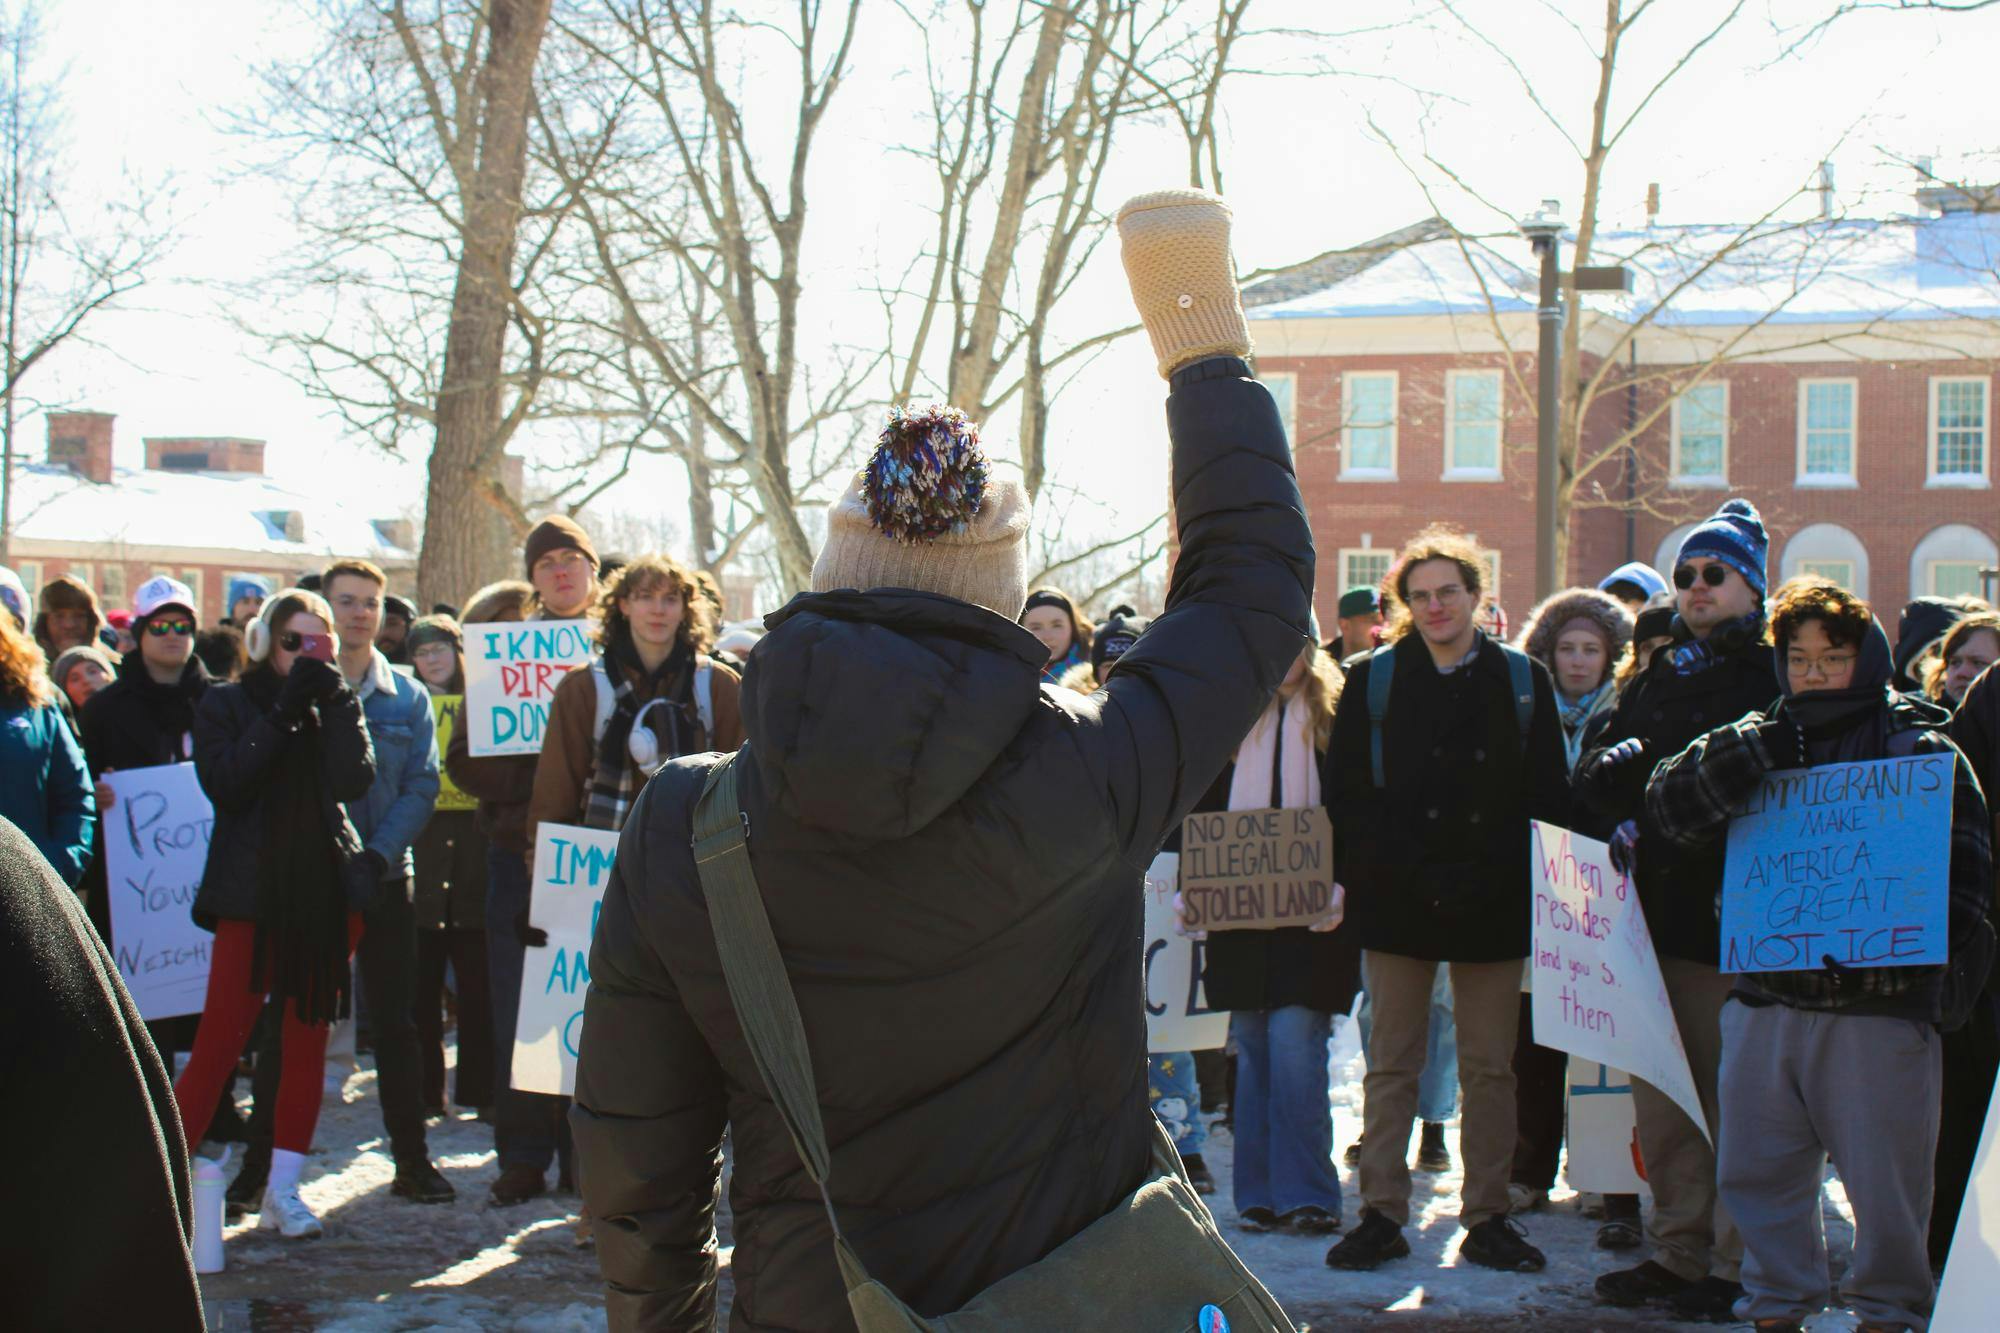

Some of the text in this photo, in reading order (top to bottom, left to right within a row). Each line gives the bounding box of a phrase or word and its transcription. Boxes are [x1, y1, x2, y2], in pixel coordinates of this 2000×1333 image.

[1188, 808, 1315, 844] NO ONE IS
[1800, 806, 1867, 837] MAKE
[1187, 840, 1321, 880] ILLEGAL ON
[1532, 821, 1602, 897] When
[1744, 841, 1873, 889] AMERICA
[1184, 883, 1265, 926] STOLEN
[1274, 880, 1329, 918] LAND
[1536, 893, 1612, 941] resides
[1767, 877, 1902, 929] GREAT
[1535, 939, 1561, 971] land
[1568, 958, 1591, 981] you
[1728, 925, 1927, 971] NOT ICE
[1559, 985, 1616, 1038] them
